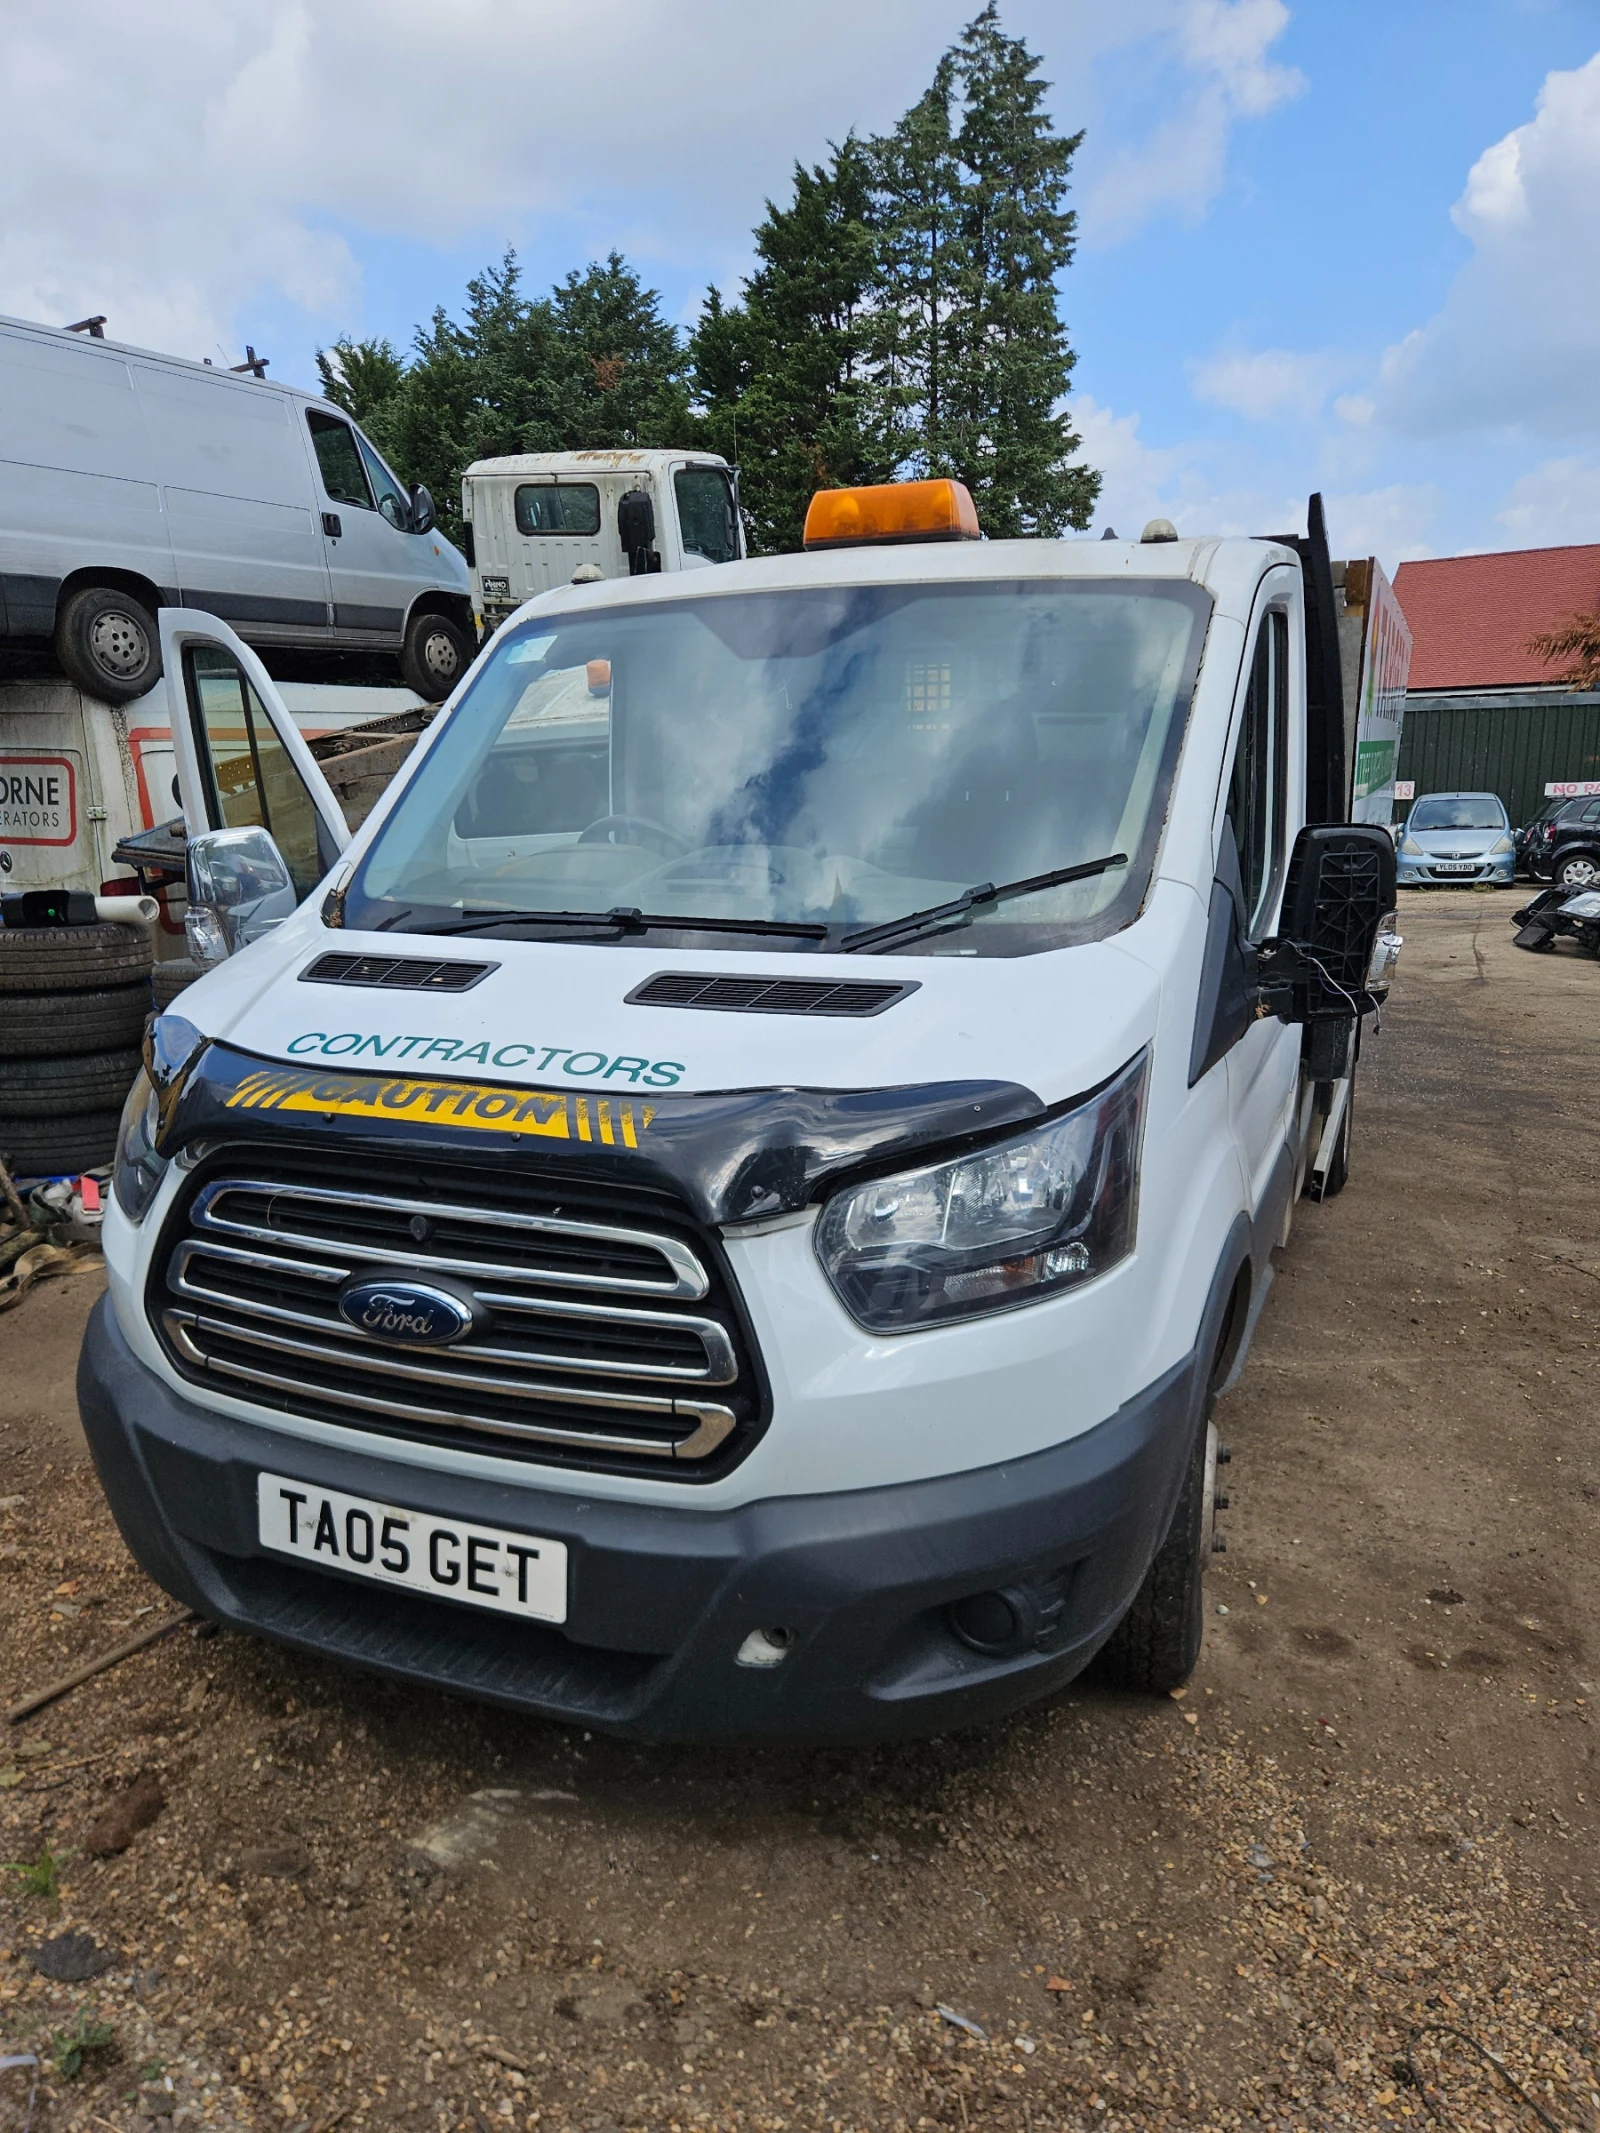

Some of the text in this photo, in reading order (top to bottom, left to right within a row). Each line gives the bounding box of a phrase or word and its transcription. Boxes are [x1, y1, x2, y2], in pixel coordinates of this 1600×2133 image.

[1397, 784, 1412, 797] 13
[1553, 783, 1578, 794] NO
[287, 1032, 686, 1087] CONTRACTORS
[310, 1077, 564, 1125] CAUTION
[362, 1293, 435, 1335] Ford
[279, 1487, 541, 1603] TA05 GET
